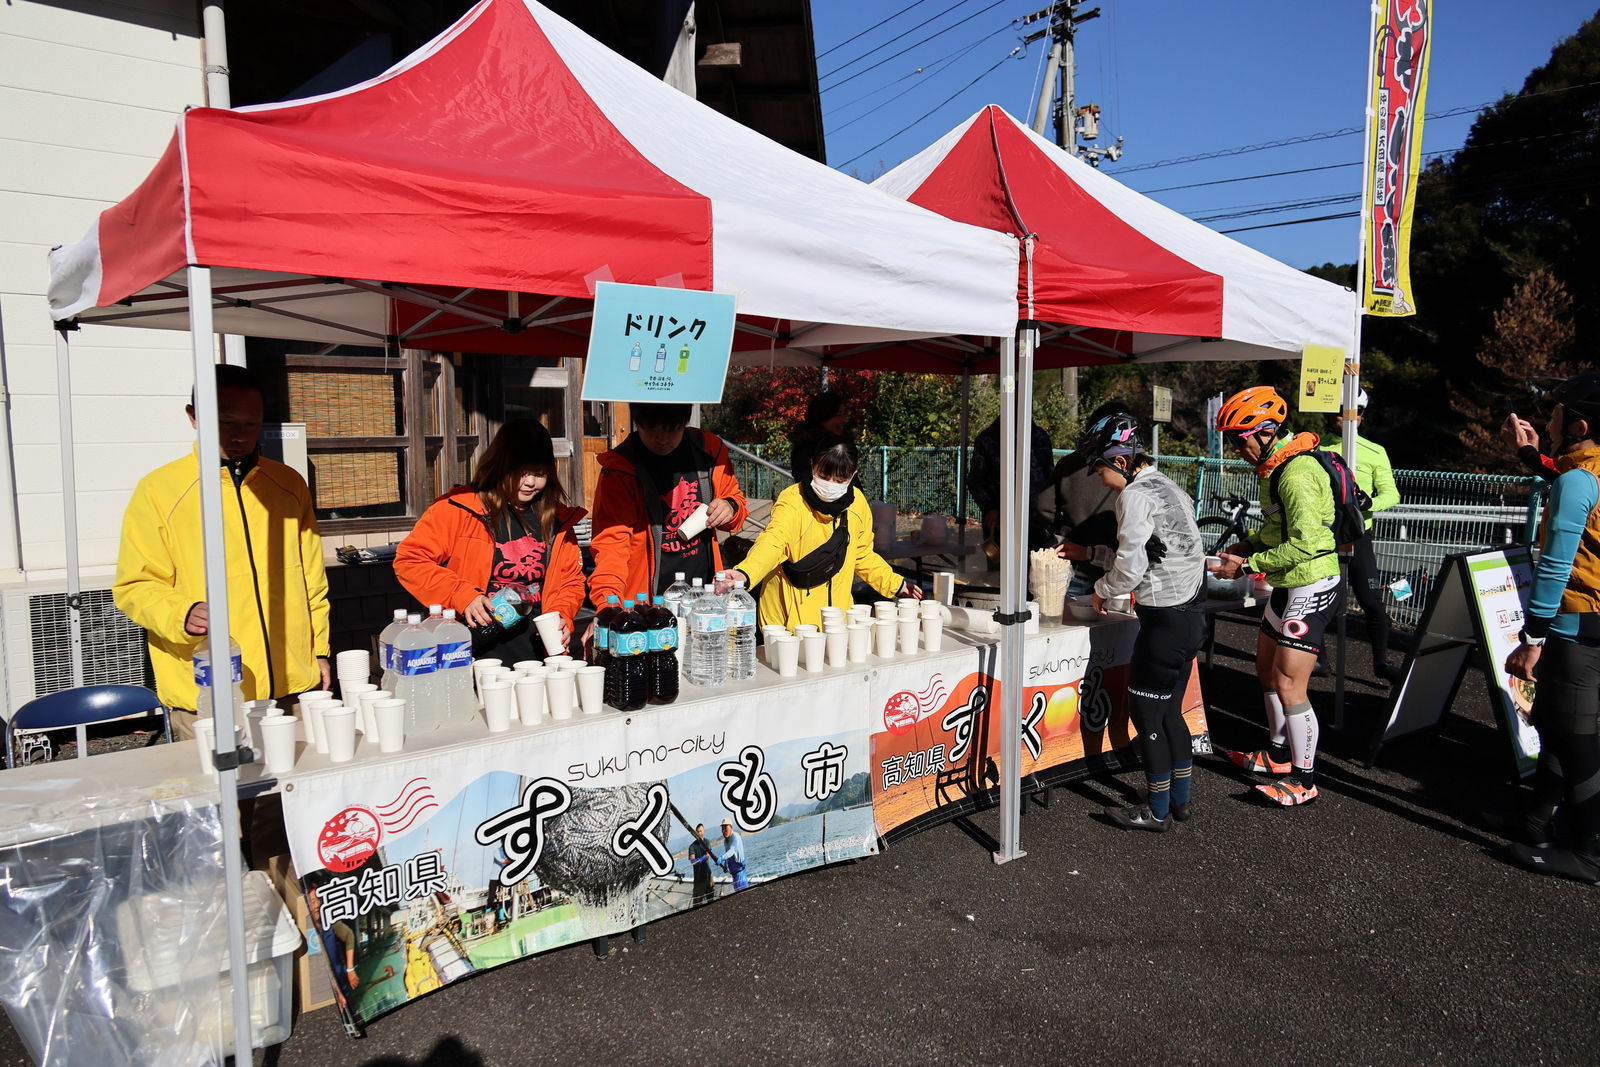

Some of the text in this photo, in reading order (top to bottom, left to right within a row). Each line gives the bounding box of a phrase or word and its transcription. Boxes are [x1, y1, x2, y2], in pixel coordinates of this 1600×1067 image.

[625, 313, 706, 341] ドリンク
[1499, 614, 1508, 625] A3
[407, 656, 437, 668] AQUARIUS
[441, 650, 471, 661] AQUARIUS
[567, 730, 727, 783] sukumo-city
[881, 743, 946, 792] 高知県
[315, 851, 449, 932] 高知県
